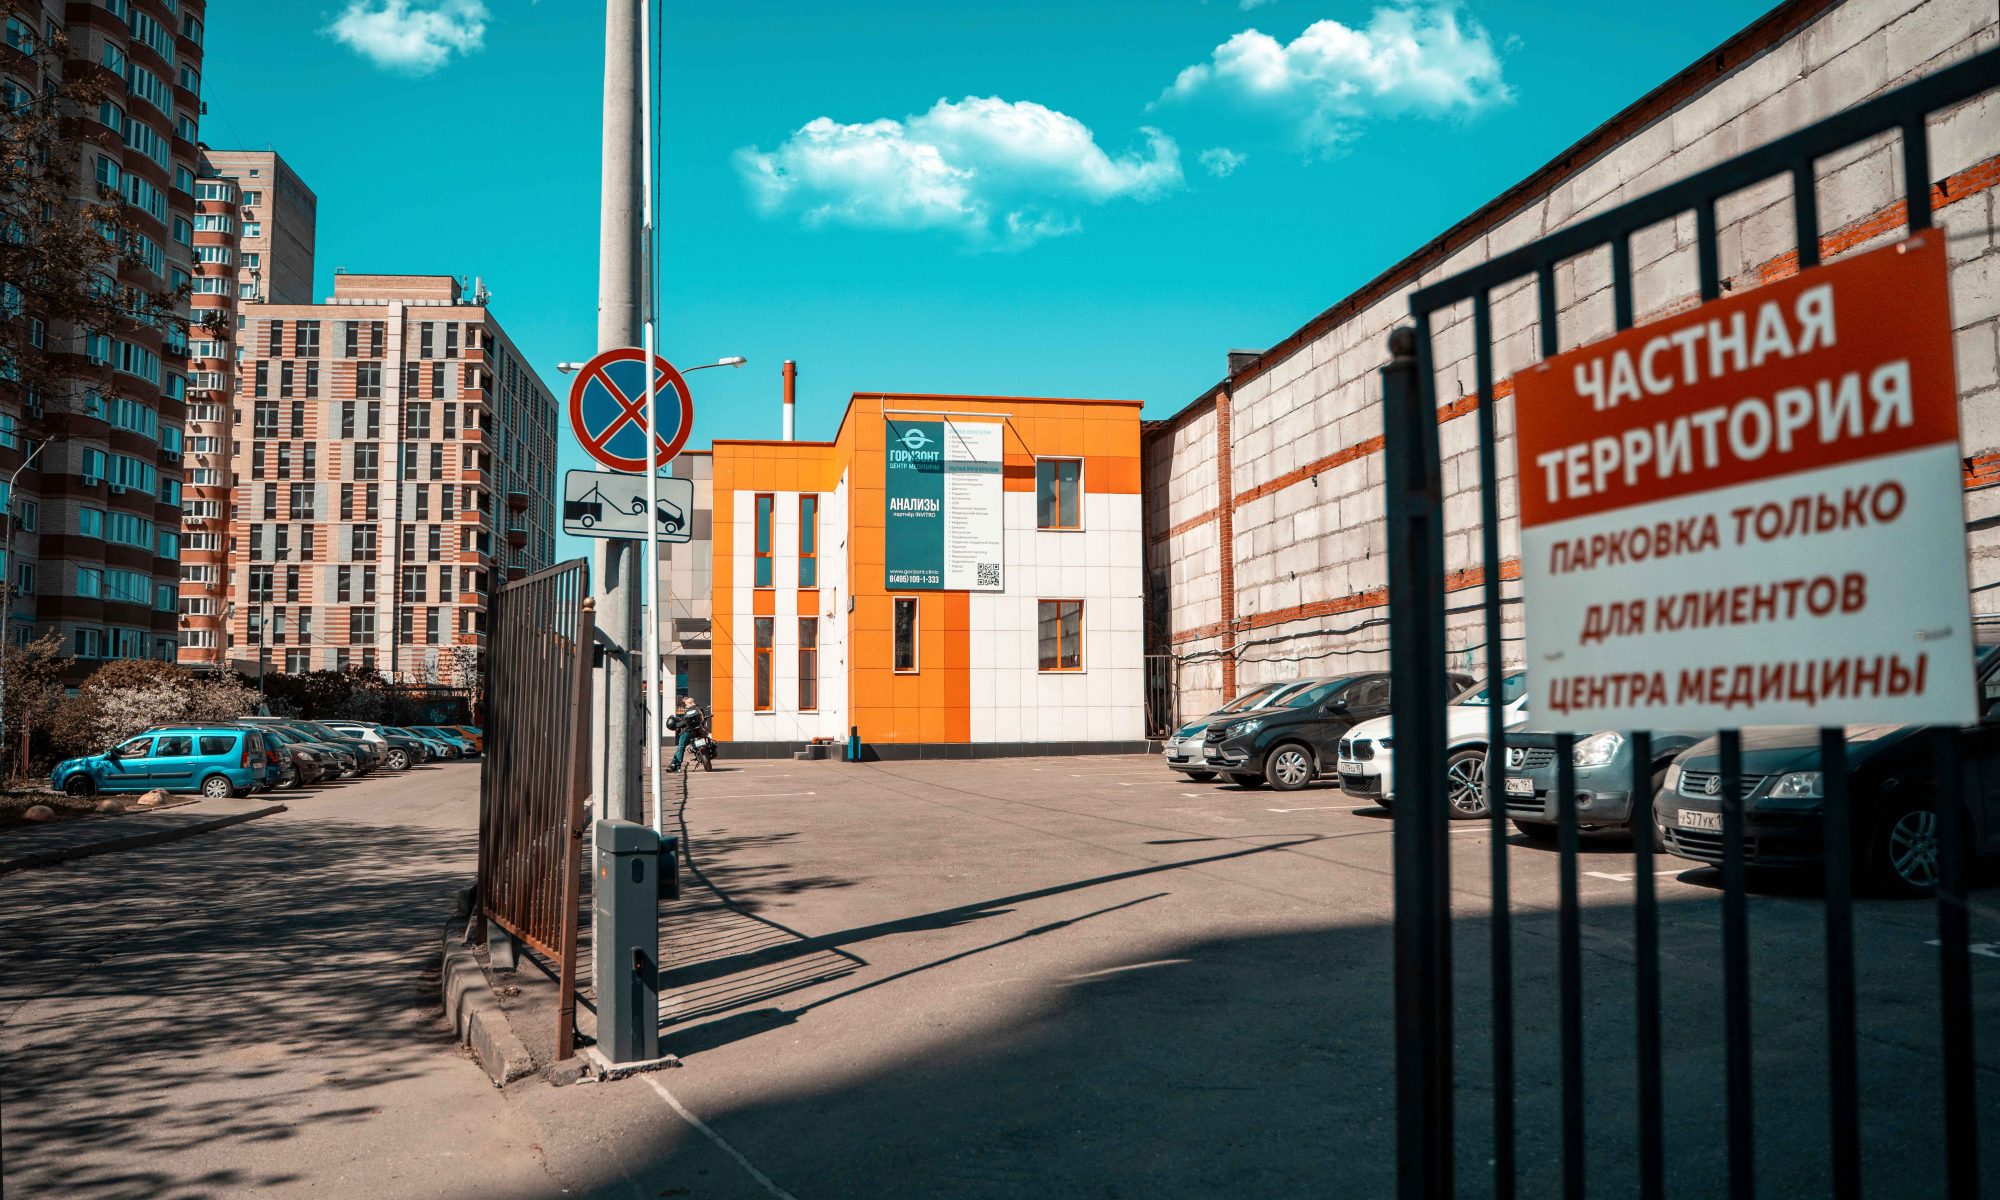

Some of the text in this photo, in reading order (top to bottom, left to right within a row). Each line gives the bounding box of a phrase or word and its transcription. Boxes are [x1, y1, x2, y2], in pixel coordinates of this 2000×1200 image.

[1574, 283, 1837, 412] ЧАСТНАЯ
[890, 450, 939, 462] ГОРИЗОНТ
[1537, 359, 1914, 503] ТЕРРИТОРИЯ
[890, 497, 939, 511] АНАЛИЗЫ
[1550, 480, 1907, 575] ПАРКОВКА ТОЛЬКО
[1579, 572, 1867, 645] ДЛЯ КЛИЕНТОВ
[1548, 652, 1928, 715] ЦЕНТРА МЕДИЦИНЫ
